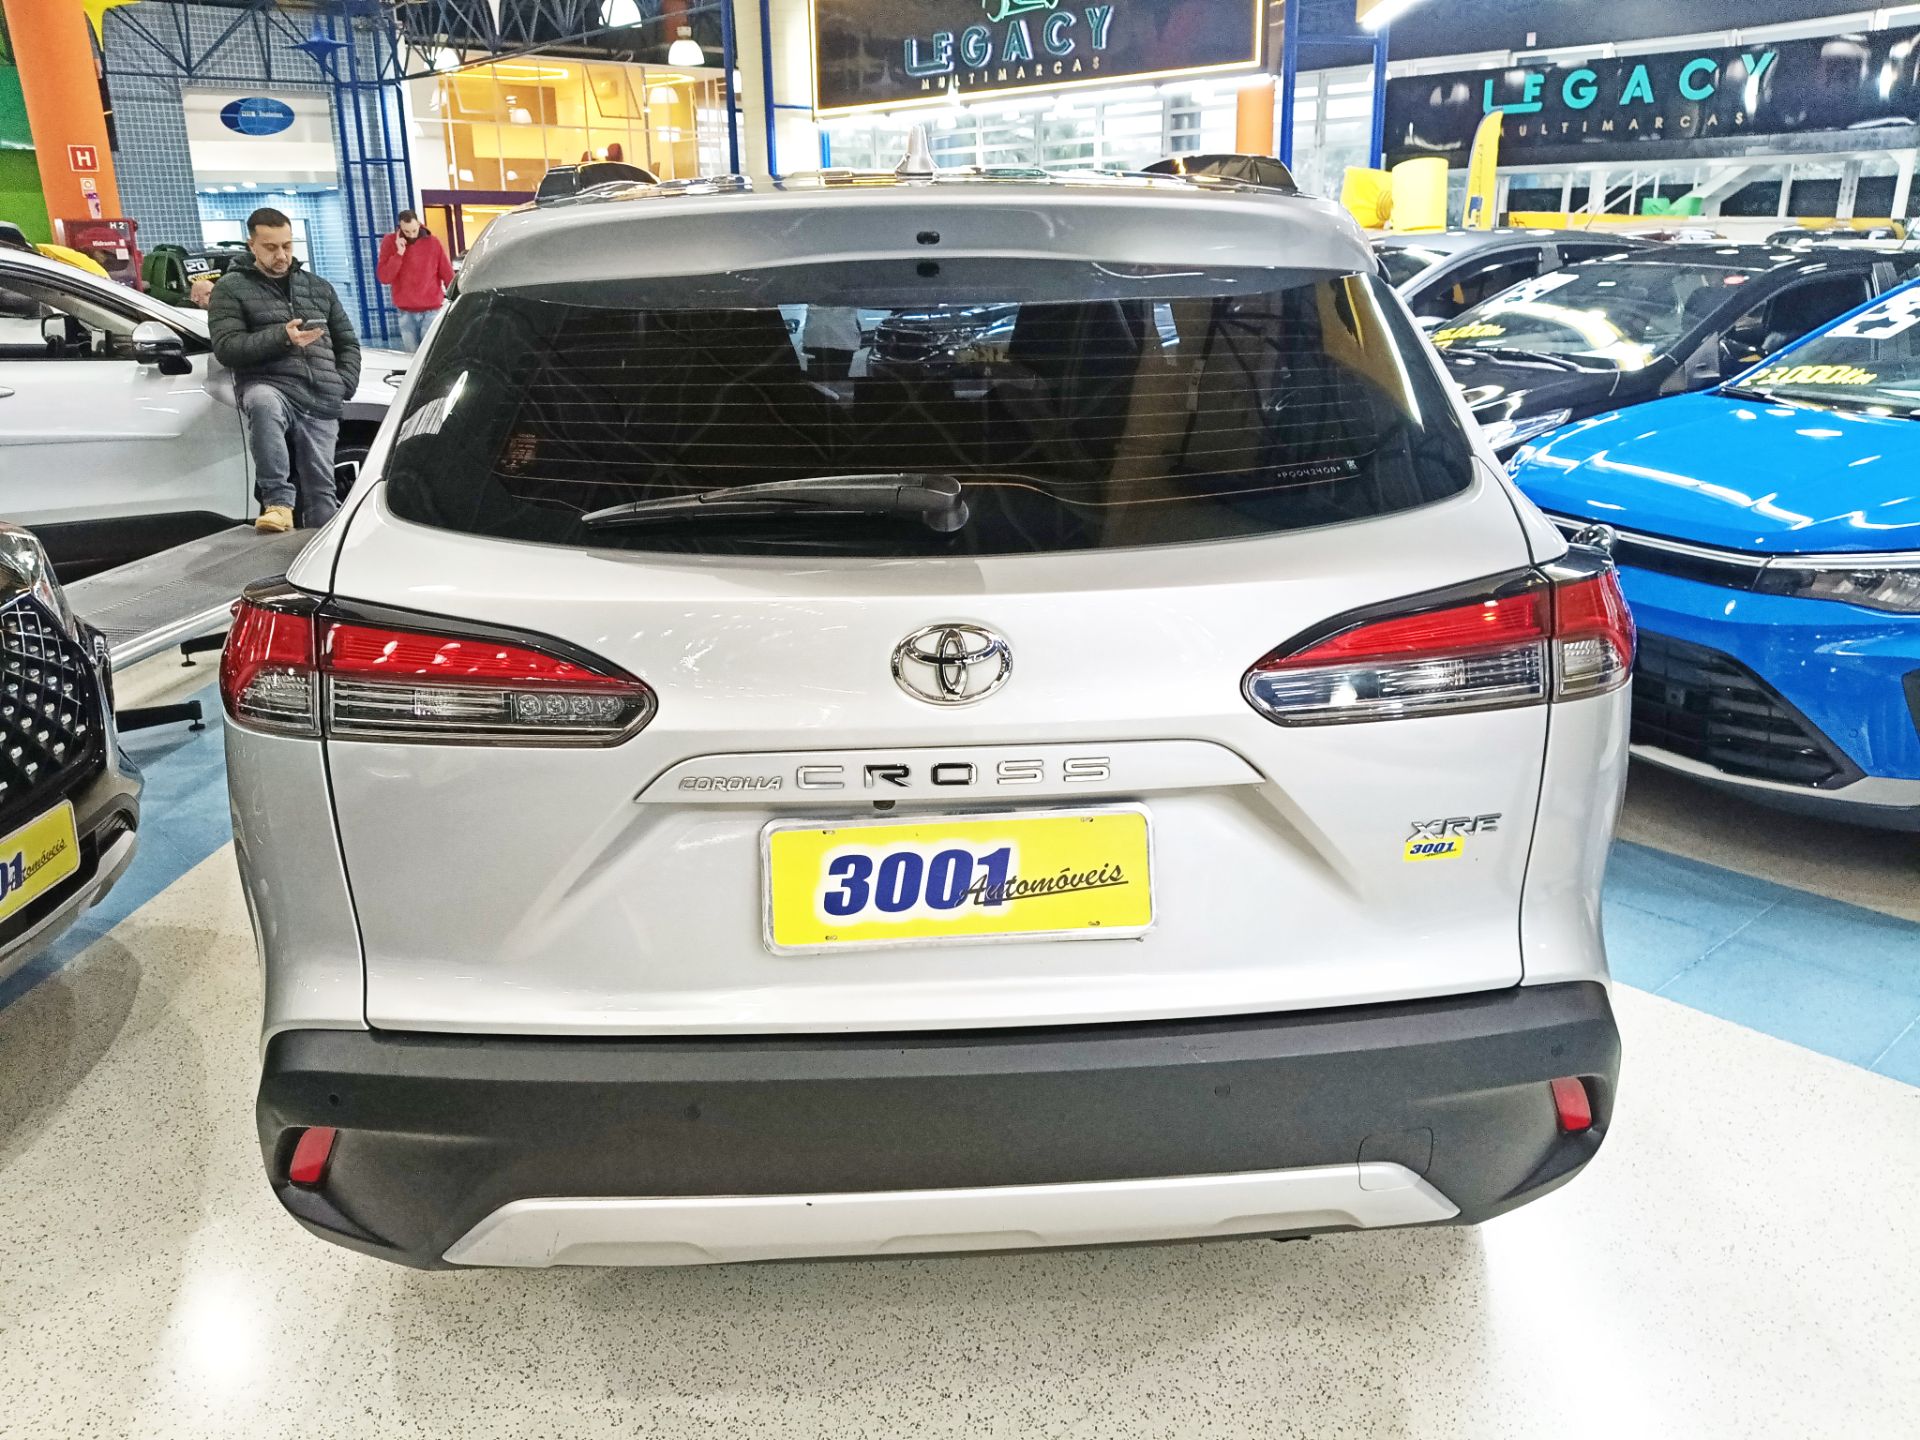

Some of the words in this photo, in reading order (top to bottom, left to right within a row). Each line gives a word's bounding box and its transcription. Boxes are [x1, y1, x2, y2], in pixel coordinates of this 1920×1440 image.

[904, 5, 1114, 77] LEGACY
[921, 56, 1100, 90] MULTIMARCAS
[1483, 51, 1776, 115] LEGACY
[1500, 111, 1744, 139] ULTIMARCAS
[76, 150, 92, 167] H
[679, 775, 783, 792] COROLLA
[796, 756, 1111, 790] CROSS
[1405, 812, 1502, 841] XRE
[1409, 841, 1455, 855] 3001
[823, 847, 1011, 916] 3001
[957, 862, 1129, 906] Automóveis
